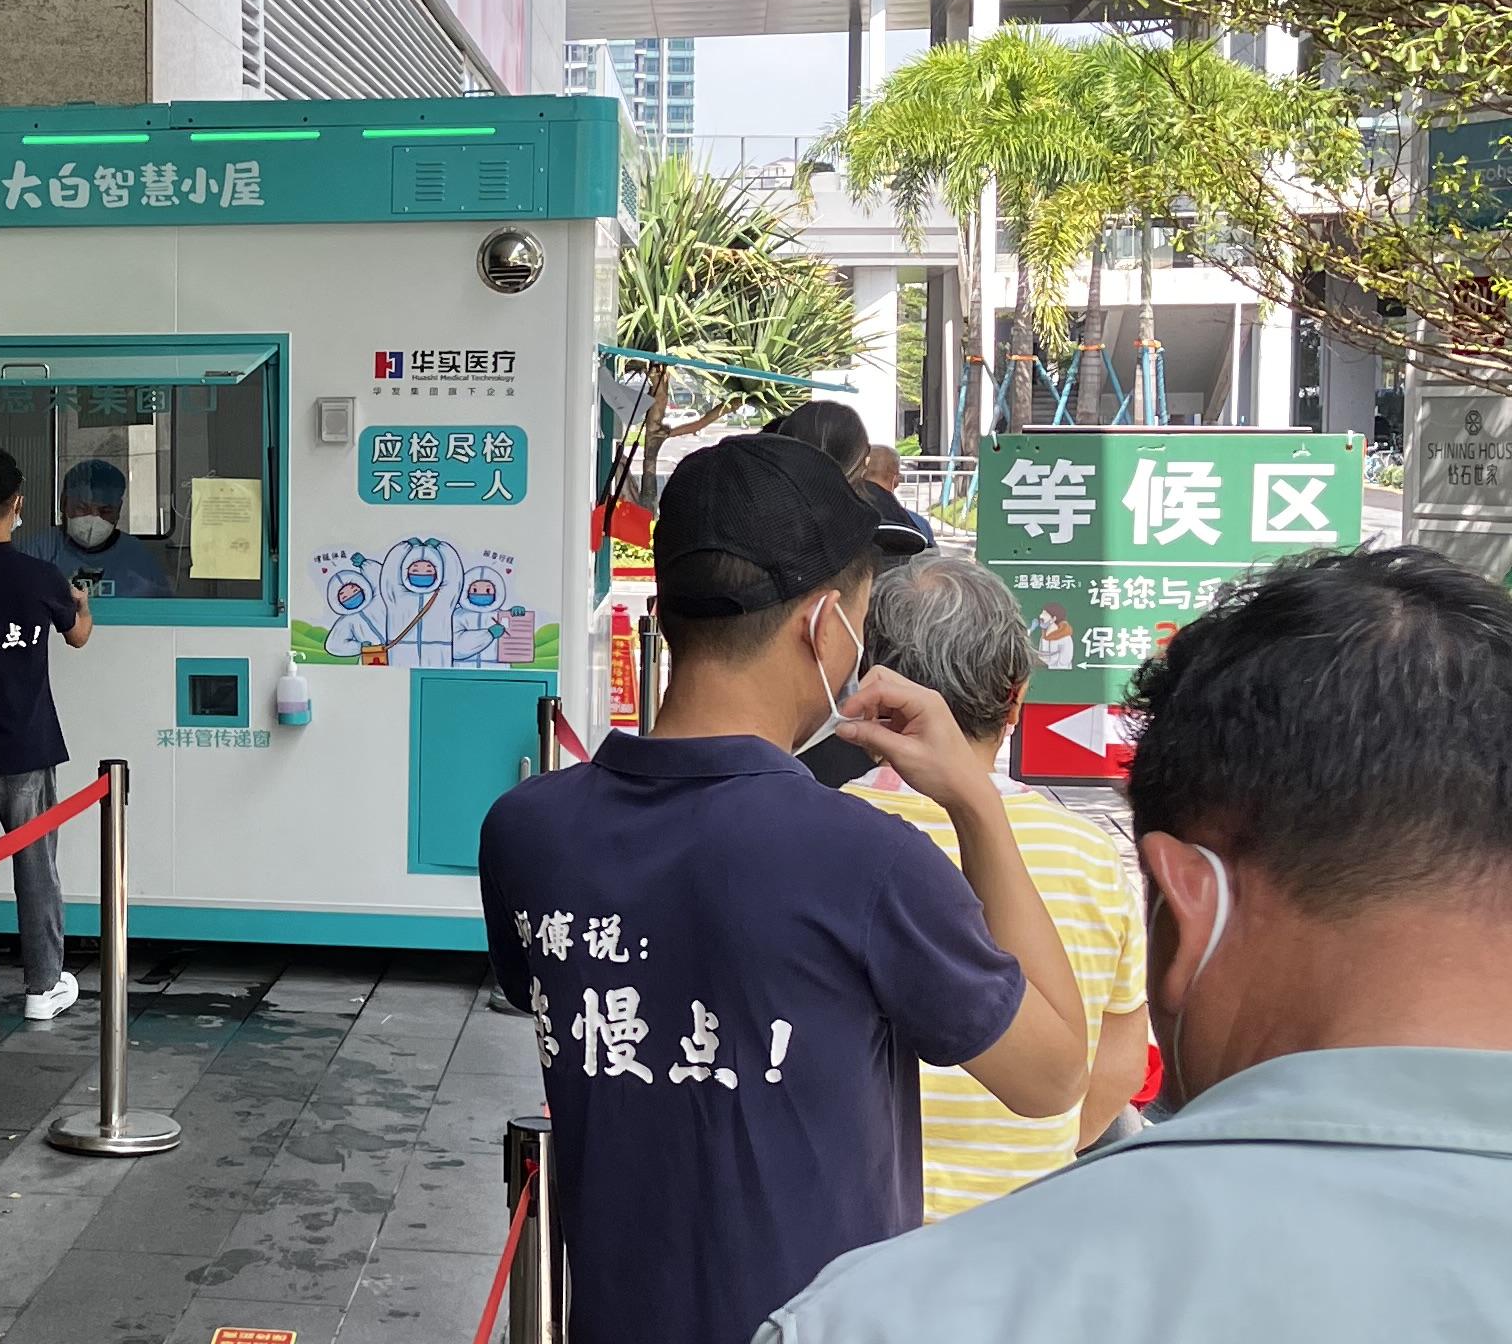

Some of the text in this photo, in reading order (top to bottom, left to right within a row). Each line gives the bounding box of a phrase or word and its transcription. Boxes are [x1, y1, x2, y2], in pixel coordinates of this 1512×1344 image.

[1, 159, 265, 210] 大白智慧小屋
[411, 350, 516, 374] 华实医疗
[440, 374, 469, 382] Medical
[471, 374, 515, 383] Technology
[373, 387, 515, 396] 华发集团旗下企业
[372, 432, 514, 463] 应检尽检
[1428, 442, 1475, 460] SHINING
[372, 469, 514, 501] 不落一人
[1001, 458, 1338, 546] 等候区
[157, 728, 270, 748] 采样管传递窗
